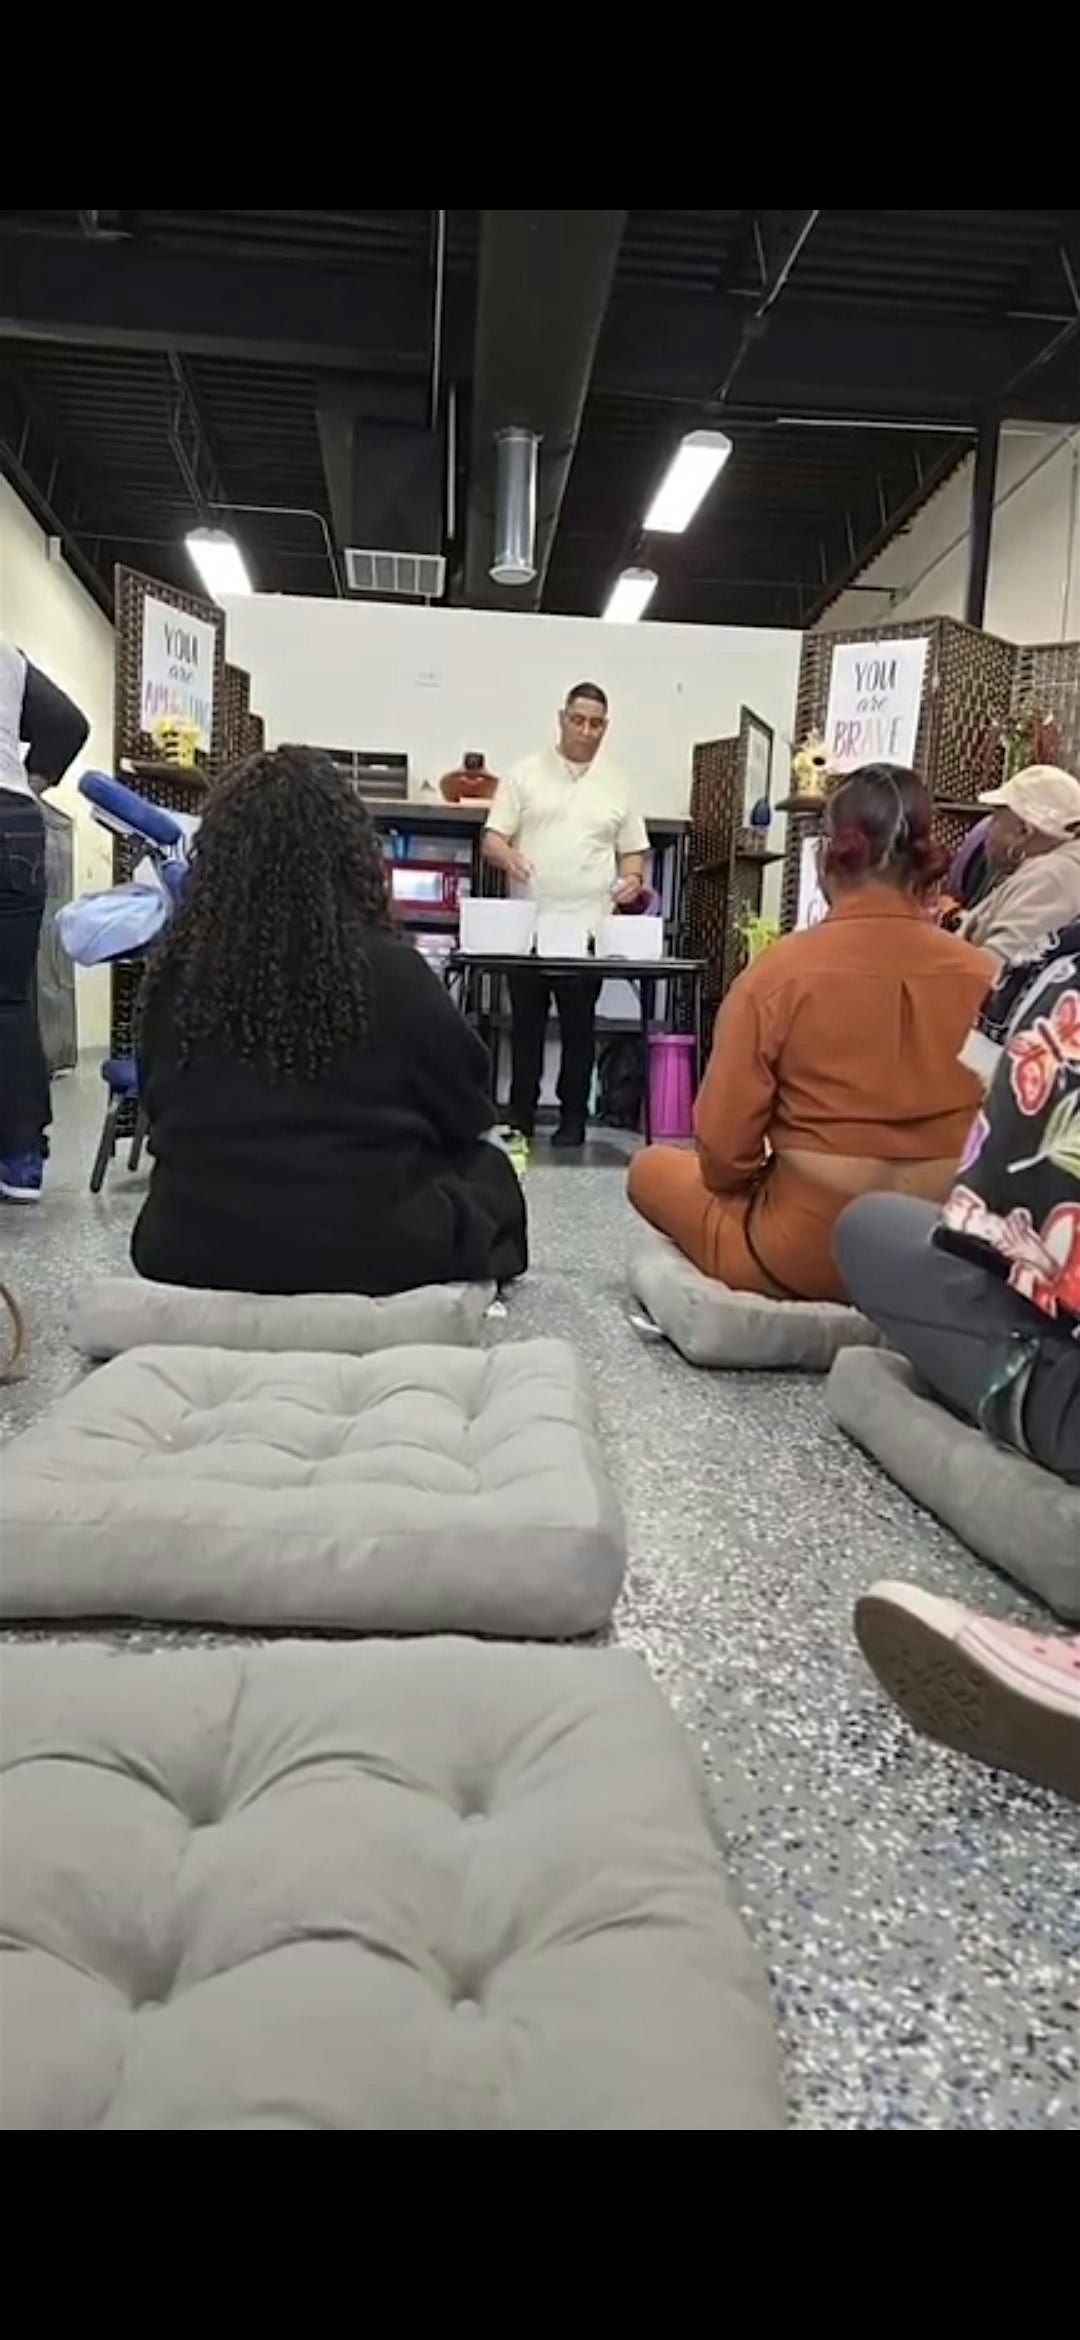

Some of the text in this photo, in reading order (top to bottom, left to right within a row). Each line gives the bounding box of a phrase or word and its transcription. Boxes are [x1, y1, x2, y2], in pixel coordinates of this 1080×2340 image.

[164, 621, 199, 666] YOU
[168, 664, 193, 684] are
[855, 659, 897, 692] YOU
[856, 693, 888, 712] are
[832, 715, 904, 758] BRAVE
